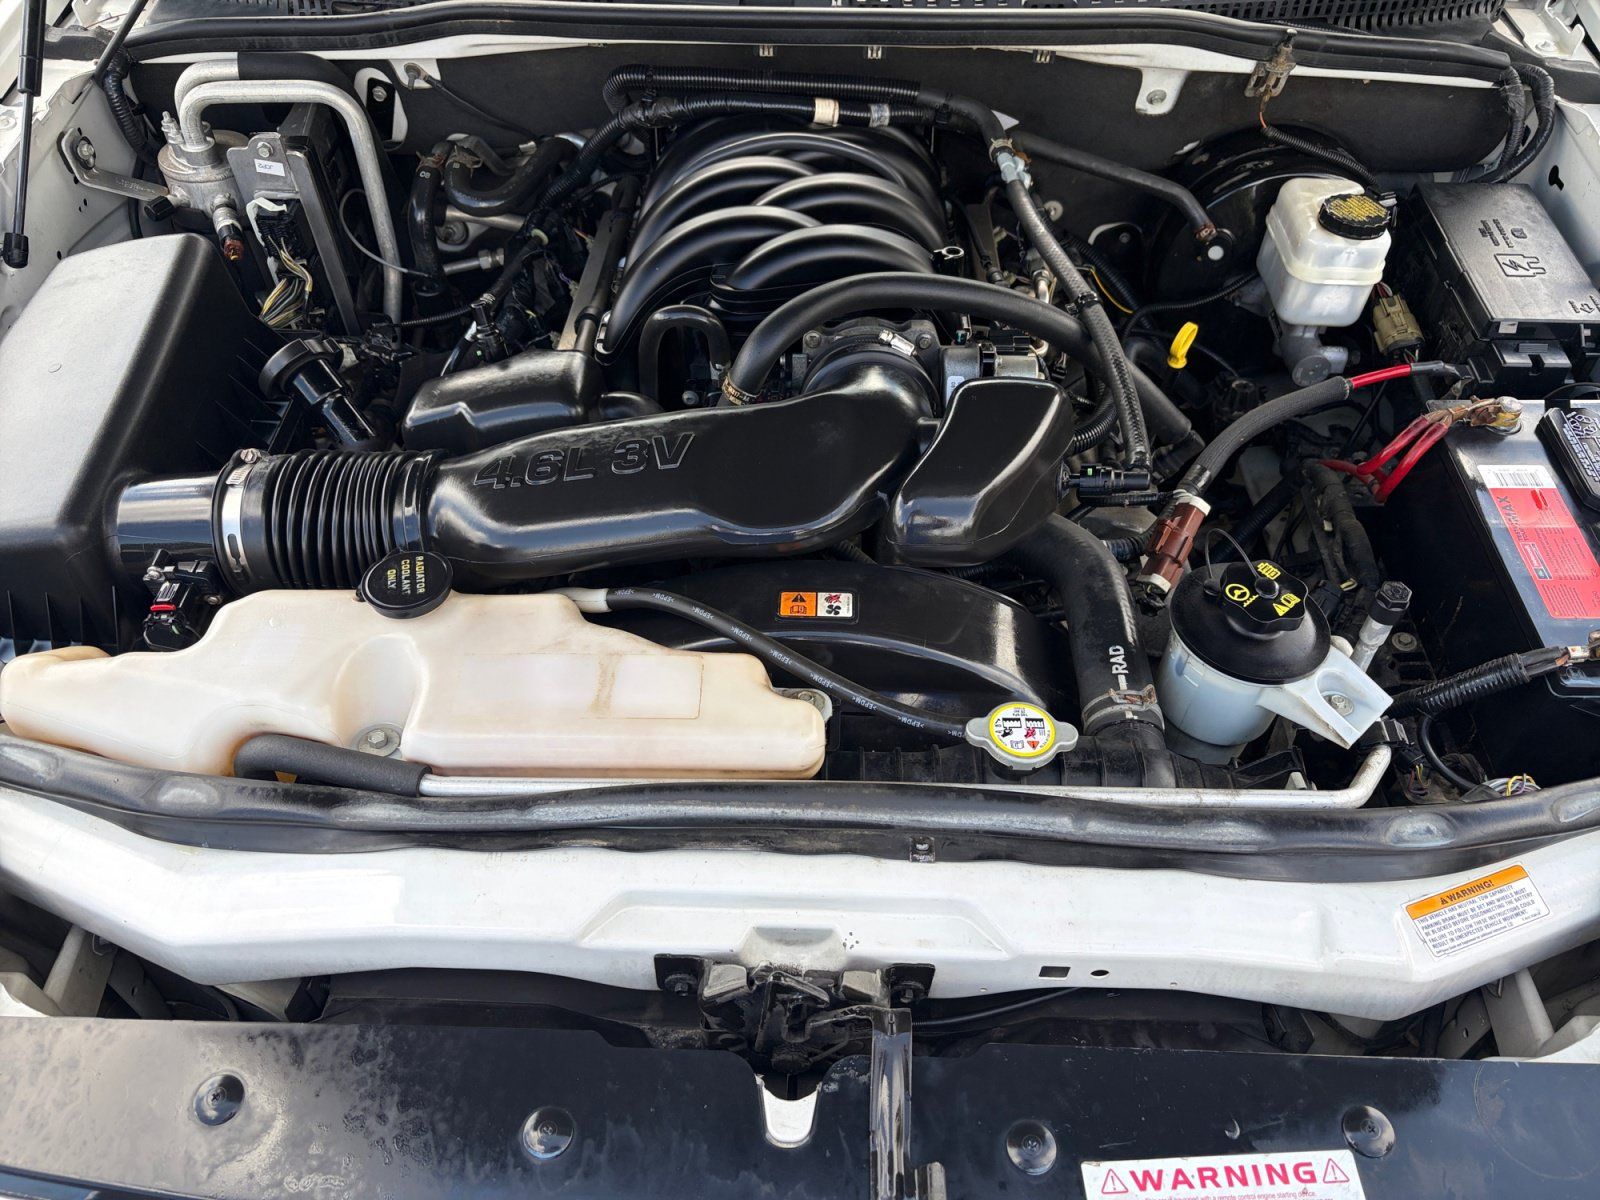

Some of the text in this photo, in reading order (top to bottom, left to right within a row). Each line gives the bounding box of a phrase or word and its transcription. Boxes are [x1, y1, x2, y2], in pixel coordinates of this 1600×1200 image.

[473, 432, 696, 490] 4.6L 3V
[387, 569, 397, 590] ONLY
[402, 560, 411, 594] COOLANT
[416, 556, 426, 594] RADIATOR
[1108, 645, 1129, 674] RAD
[1447, 881, 1494, 902] WARNING!
[1129, 1162, 1317, 1192] WARNING
